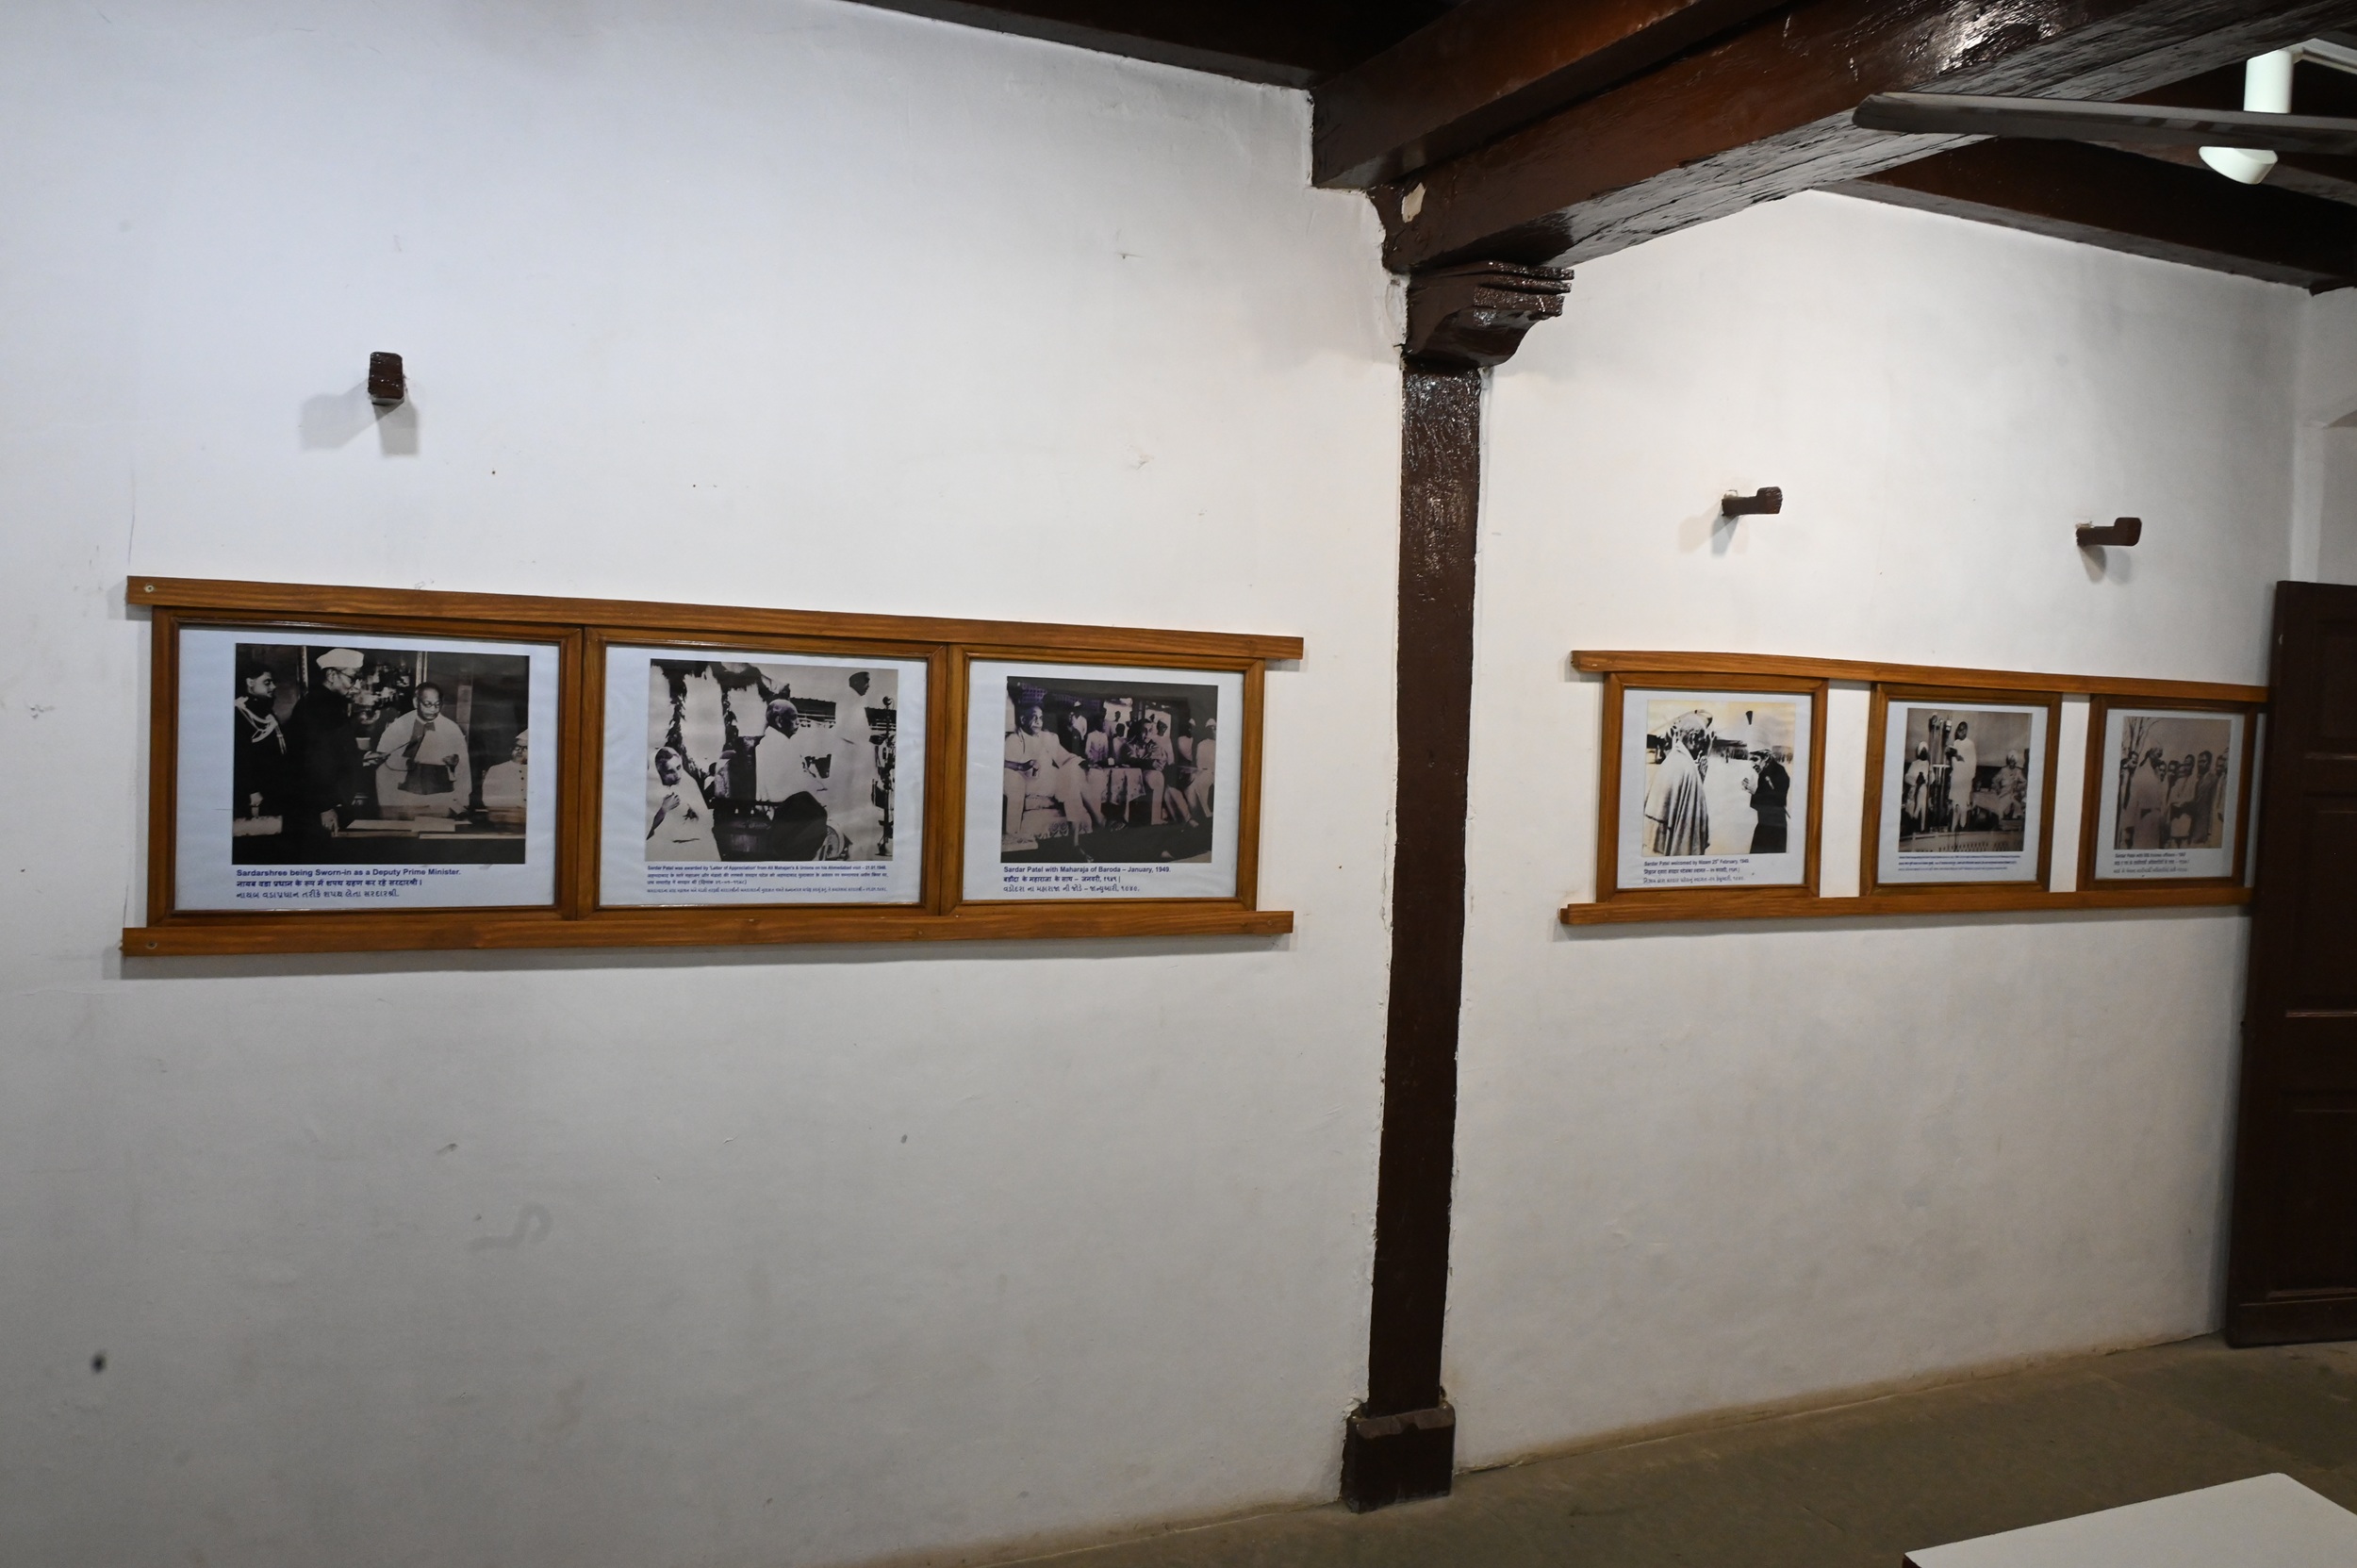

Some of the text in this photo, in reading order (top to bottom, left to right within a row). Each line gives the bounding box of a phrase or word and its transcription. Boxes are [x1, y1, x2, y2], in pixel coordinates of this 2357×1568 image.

[289, 868, 313, 878] being
[373, 868, 401, 877] Deputy
[295, 879, 302, 887] के
